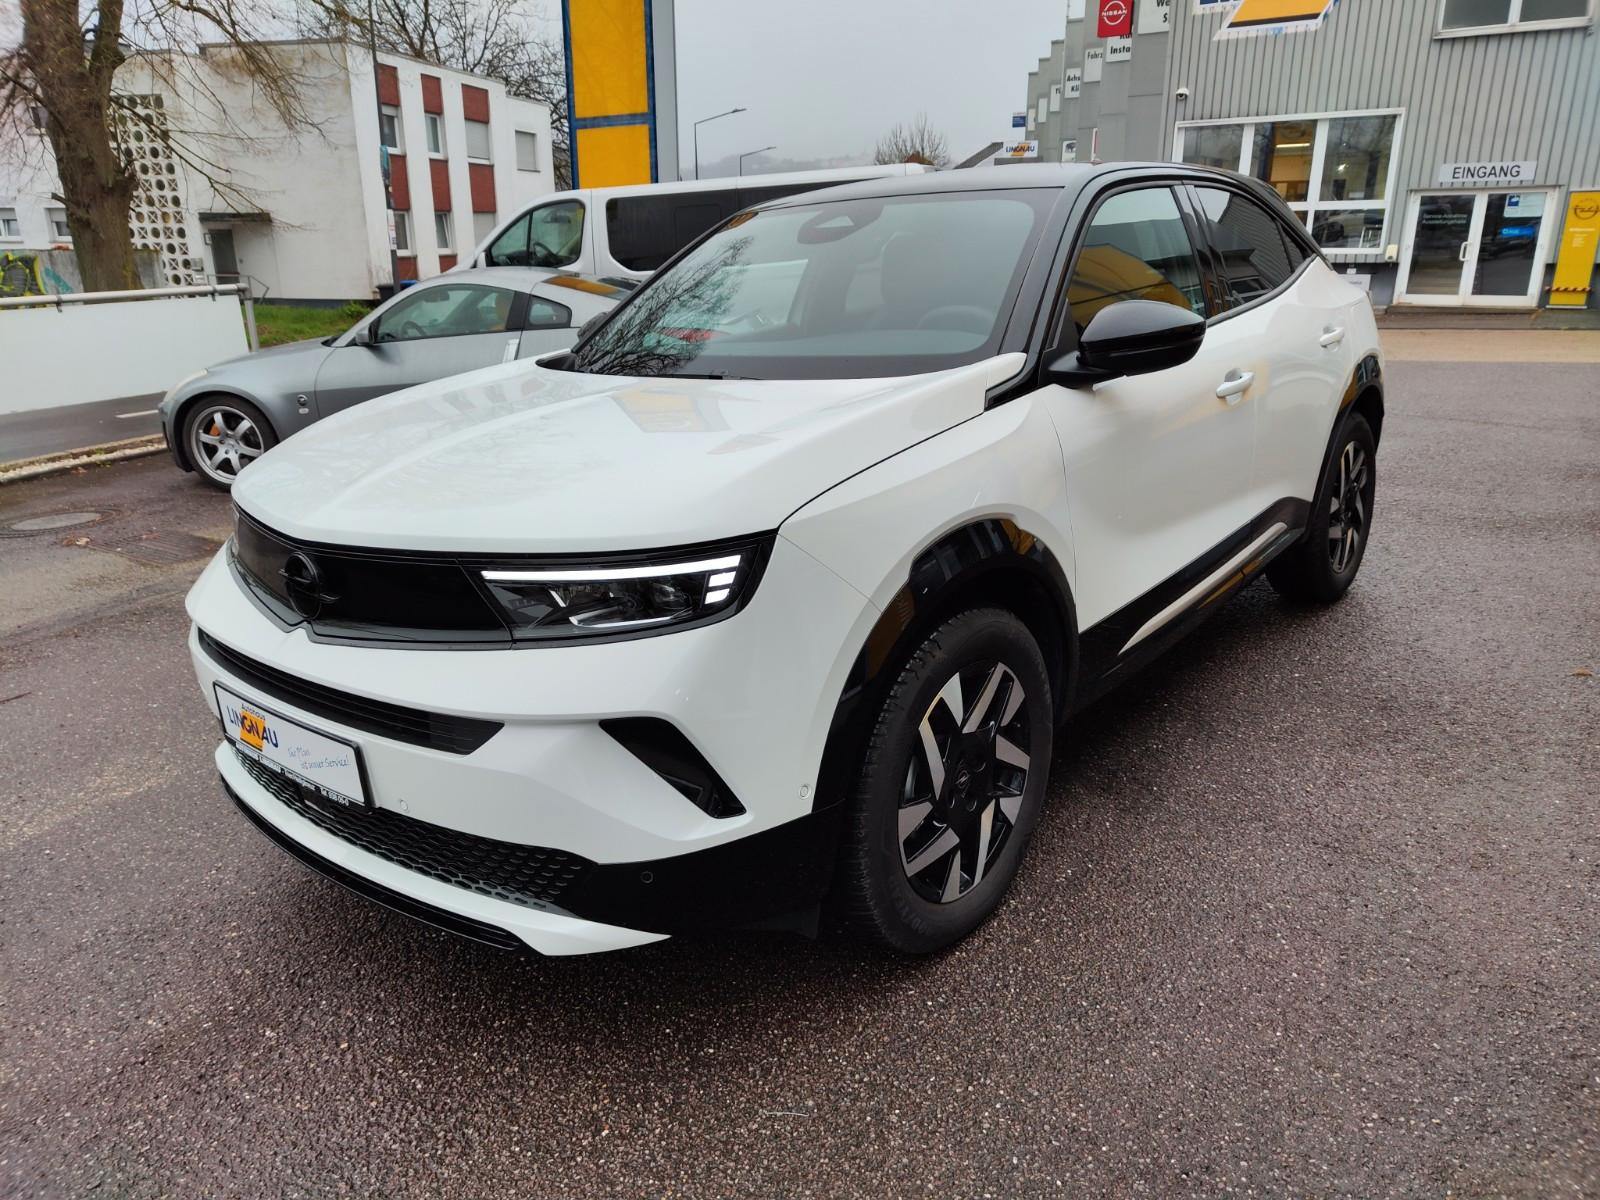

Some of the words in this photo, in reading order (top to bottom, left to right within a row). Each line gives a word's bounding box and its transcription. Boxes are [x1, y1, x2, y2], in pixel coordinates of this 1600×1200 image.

[1101, 9, 1127, 17] NISSAN
[1110, 45, 1131, 55] Insta
[1005, 144, 1035, 153] LINGNAU
[1452, 165, 1521, 180] EINGANG
[226, 705, 279, 749] LINGNAU
